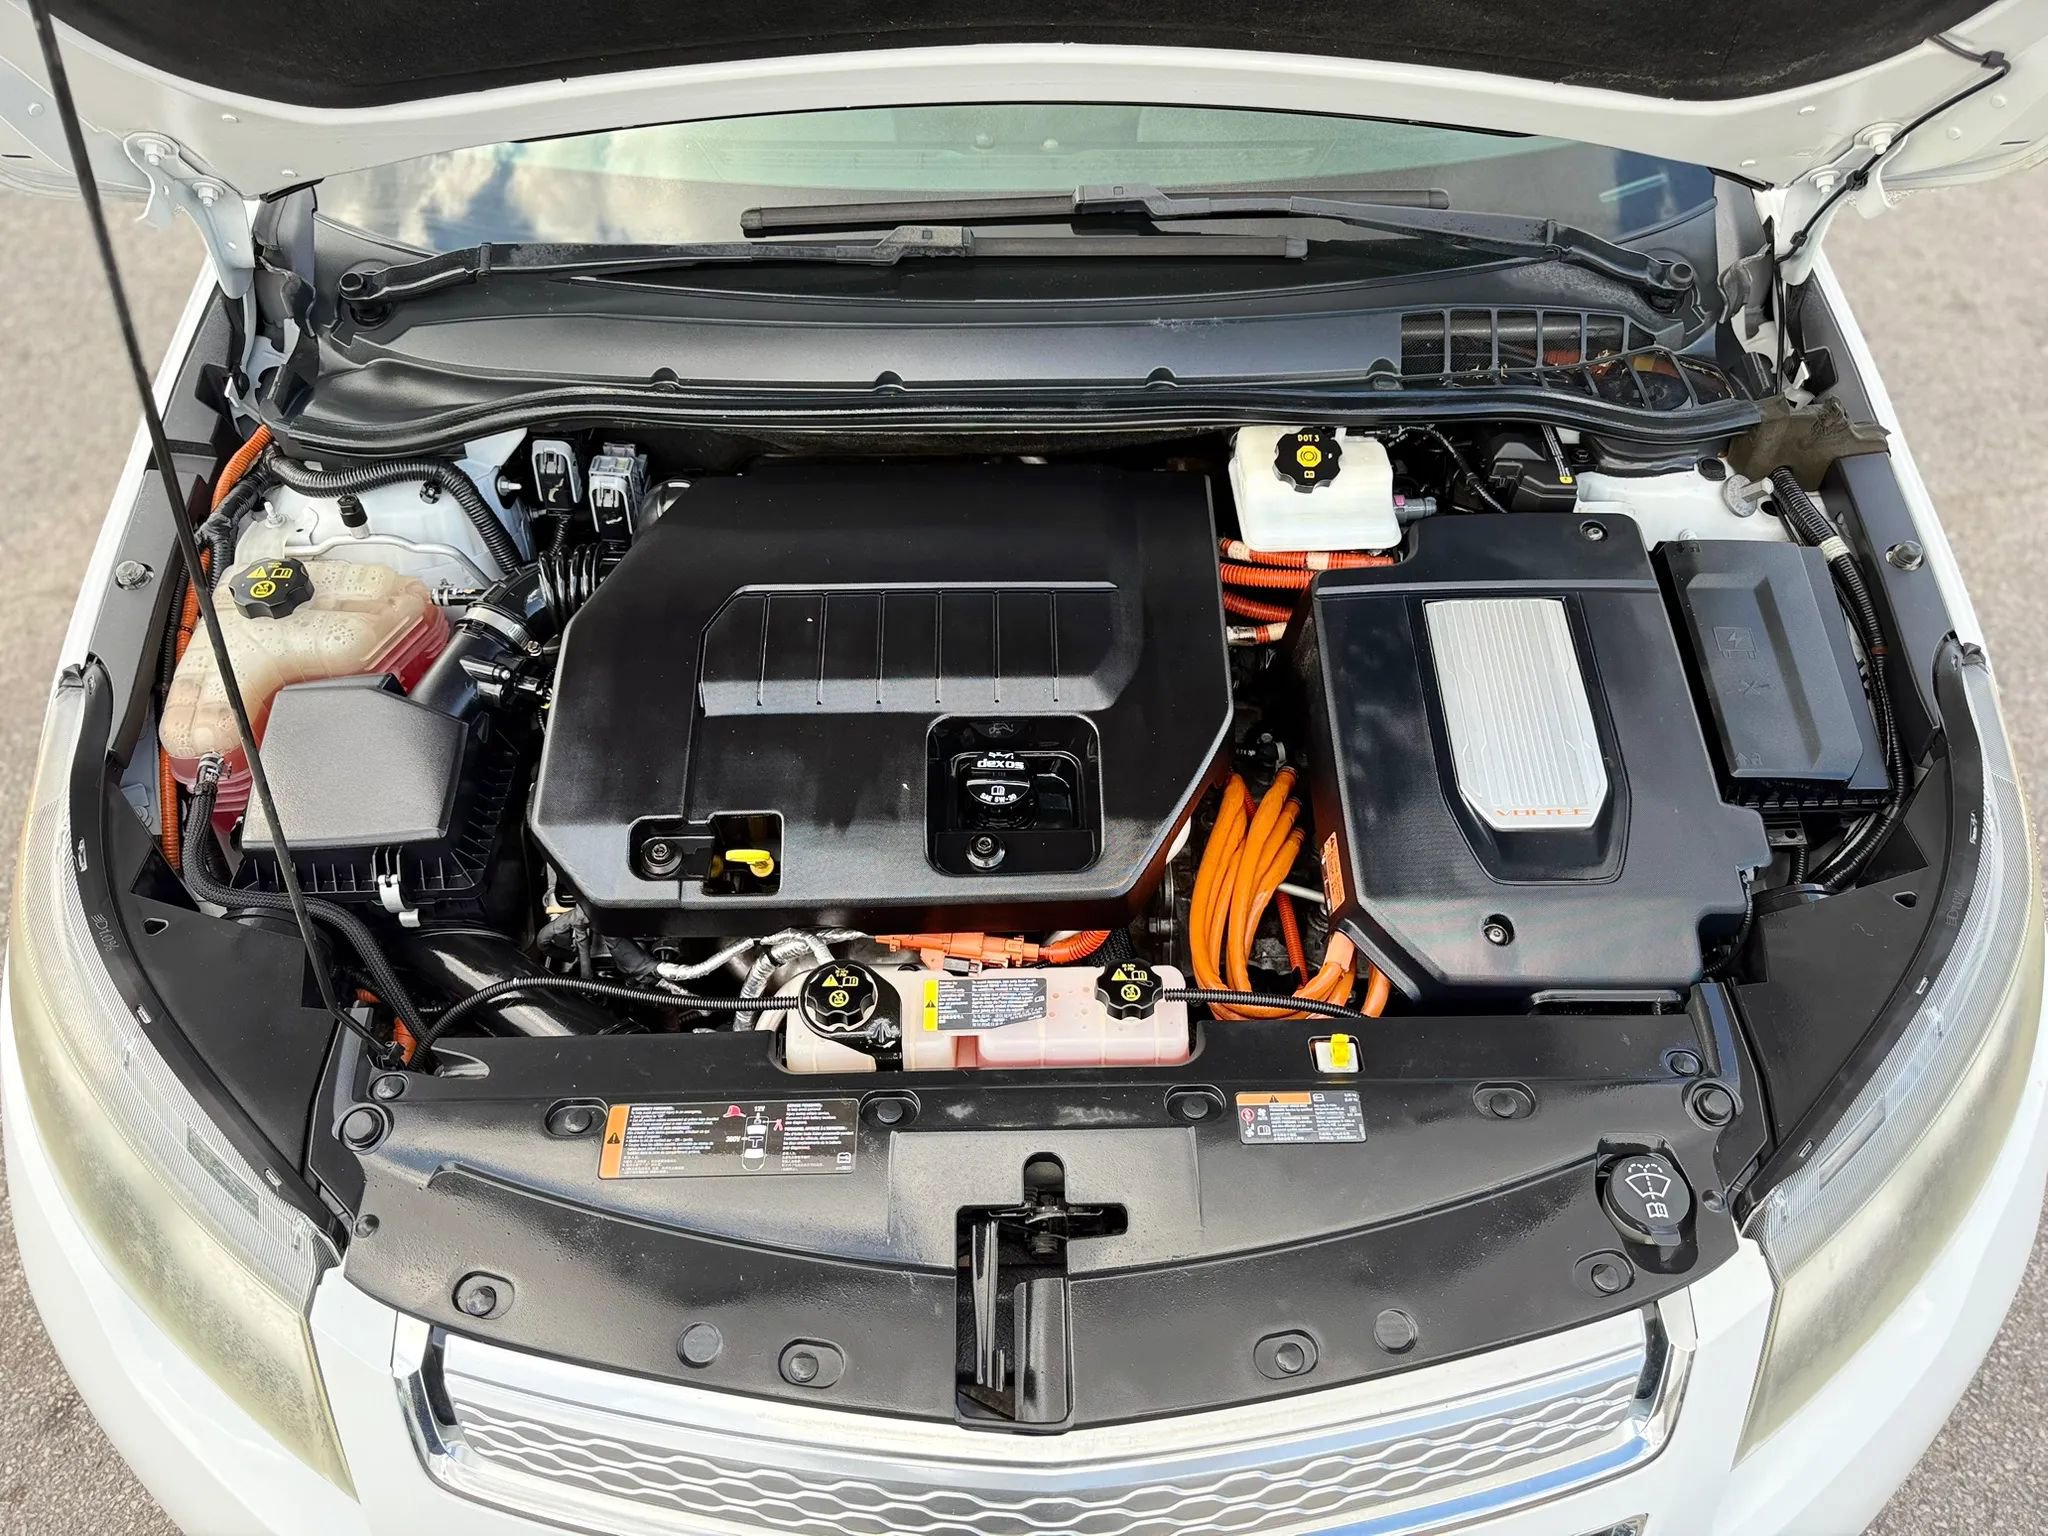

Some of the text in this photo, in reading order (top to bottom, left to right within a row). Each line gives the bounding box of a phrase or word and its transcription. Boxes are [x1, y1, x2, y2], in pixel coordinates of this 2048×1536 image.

[1297, 434, 1320, 442] DOT 3
[977, 758, 1025, 769] dexos
[979, 792, 994, 802] SAE
[98, 928, 120, 952] 1.0%
